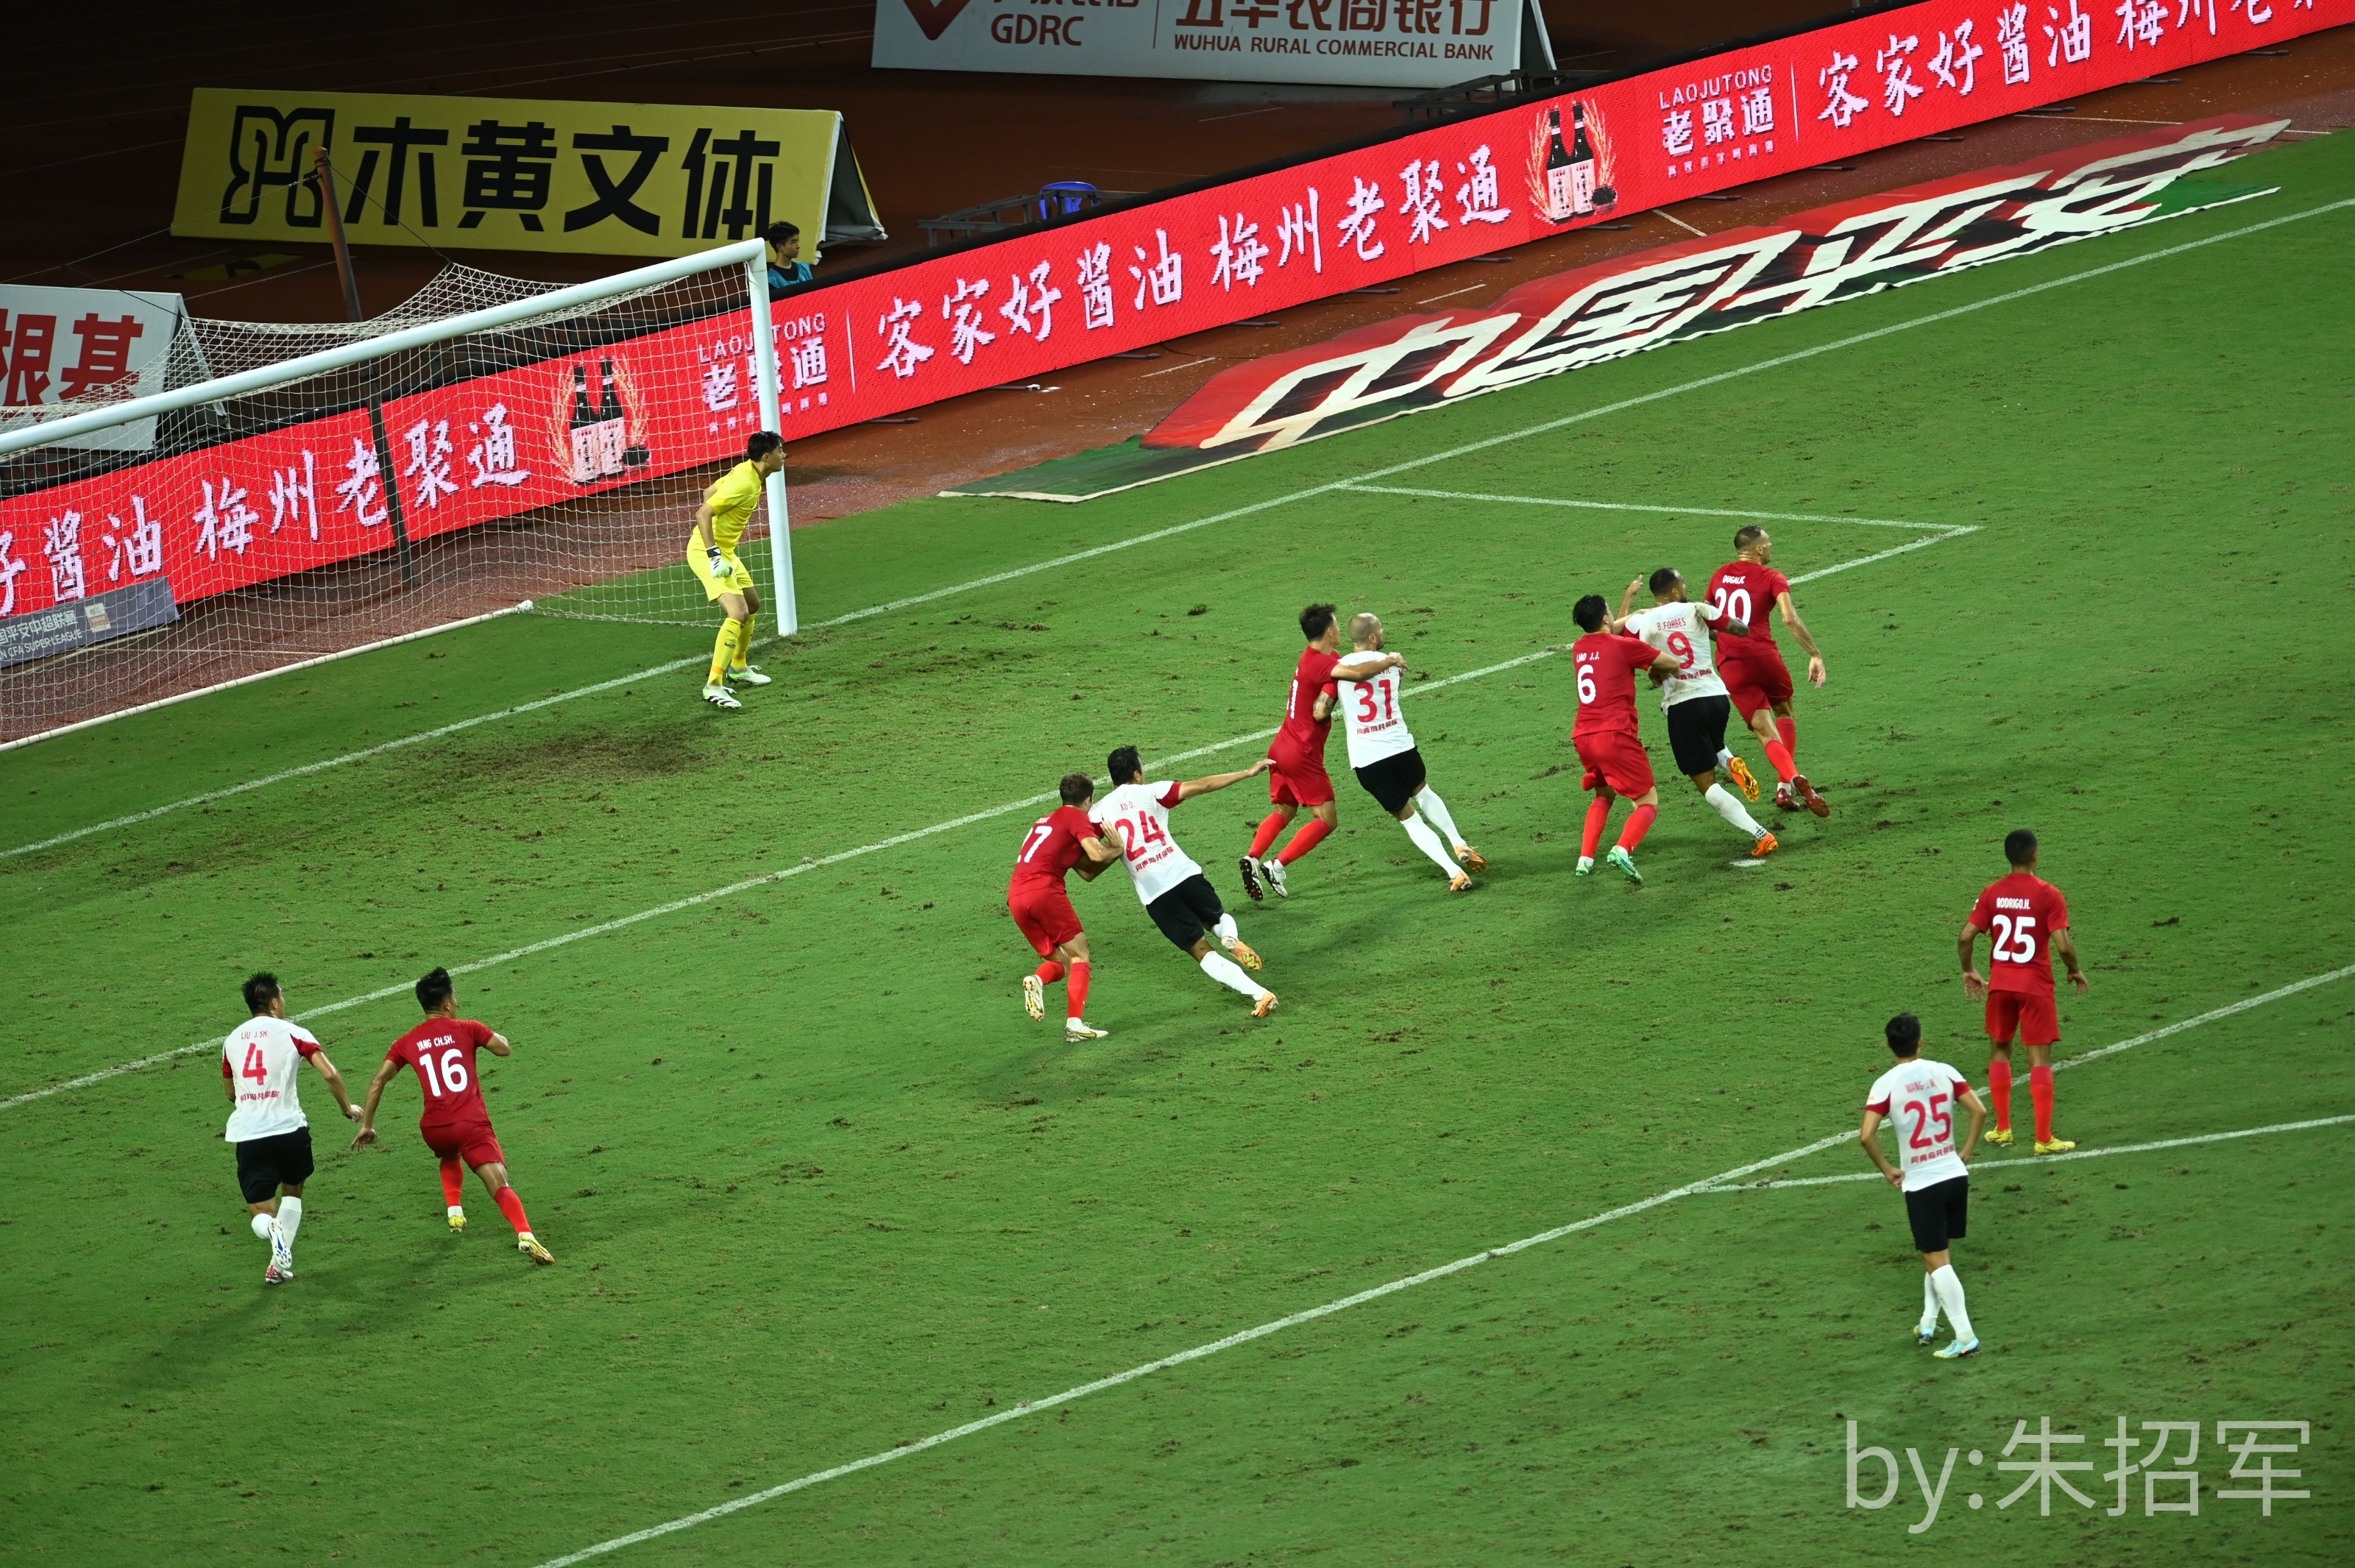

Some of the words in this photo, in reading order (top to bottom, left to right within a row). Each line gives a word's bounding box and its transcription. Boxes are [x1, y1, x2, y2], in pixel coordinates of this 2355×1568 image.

[991, 13, 1084, 46] GDRC
[1174, 34, 1242, 52] WUHUA
[1250, 37, 1311, 54] RURAL
[1316, 39, 1438, 58] COMMERCIAL
[1444, 43, 1494, 60] BANK
[1659, 64, 1773, 110] LAOJUTONG
[1662, 87, 1774, 157] 老聚通
[344, 116, 781, 239] 木黄文体
[698, 313, 826, 363] LAOJTONG
[1657, 617, 1686, 631] B.FORBES
[1715, 587, 1752, 626] 20
[8, 645, 24, 657] CFA
[24, 637, 52, 653] SUPER
[52, 629, 83, 645] LEAGUE
[1667, 631, 1695, 670] 9
[1354, 679, 1392, 723] 31
[1577, 664, 1596, 704] 6
[1115, 810, 1167, 862] 24
[1996, 897, 2031, 909] RODRIGO.H.
[1992, 914, 2036, 963] 25
[241, 1032, 251, 1040] LIU
[417, 1039, 432, 1051] YANG
[433, 1035, 456, 1047] CH.SH.
[243, 1042, 268, 1085] 4
[419, 1048, 468, 1097] 16
[1904, 1093, 1952, 1149] 25
